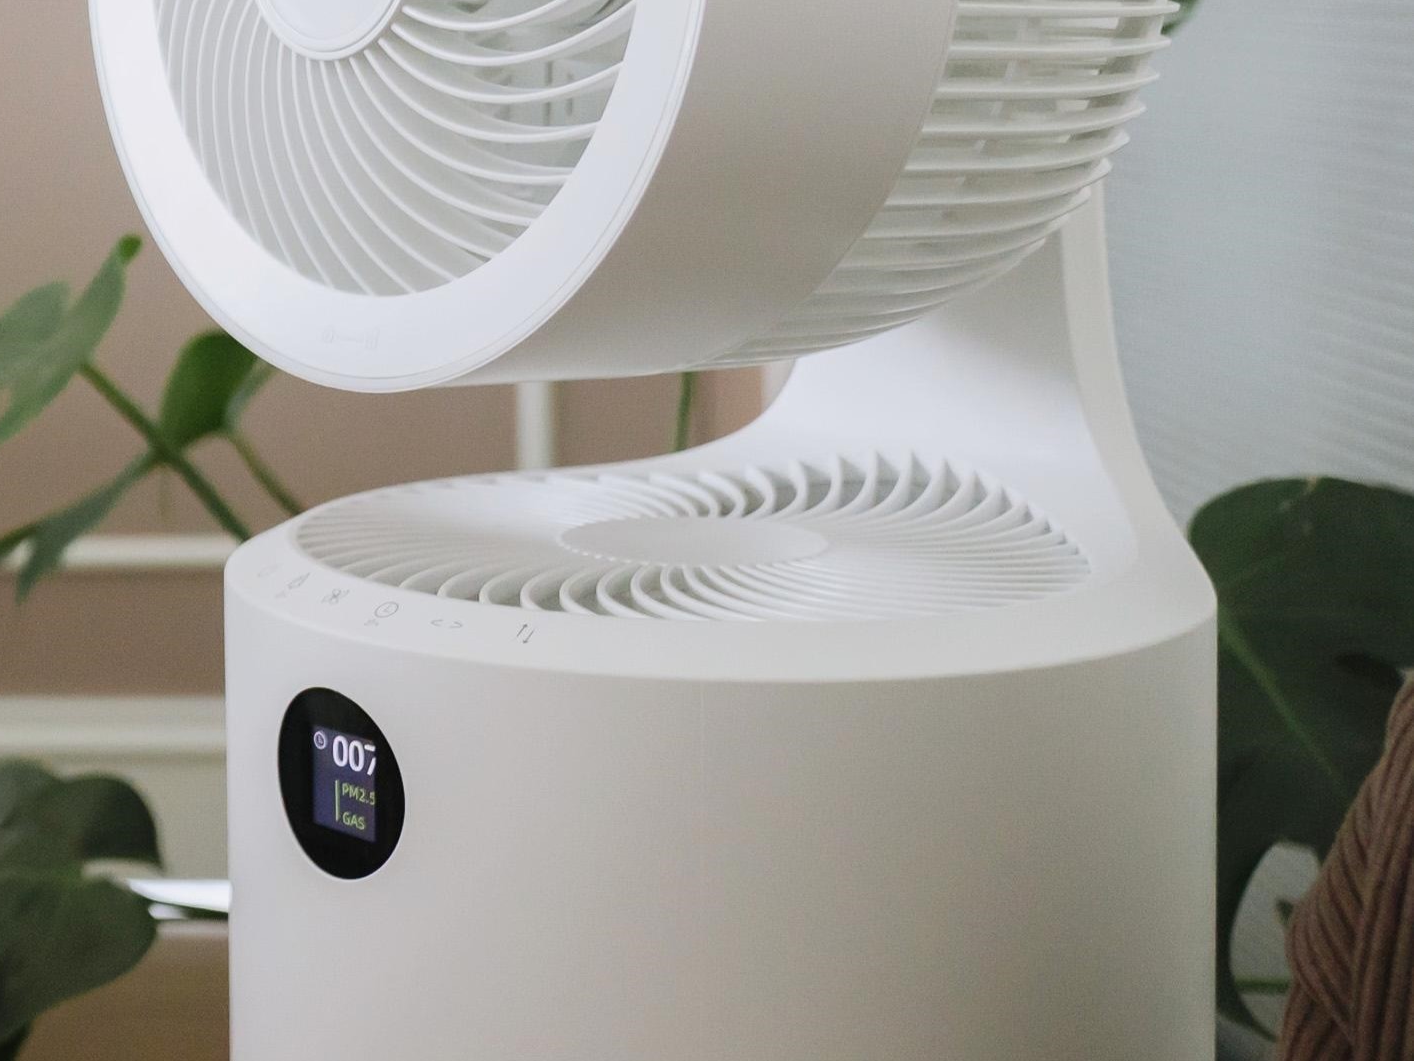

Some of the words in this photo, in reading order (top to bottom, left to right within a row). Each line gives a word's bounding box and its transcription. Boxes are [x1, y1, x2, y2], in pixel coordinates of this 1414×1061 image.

[333, 735, 377, 776] 007
[342, 783, 376, 805] PM2.5
[343, 812, 366, 830] GAS
